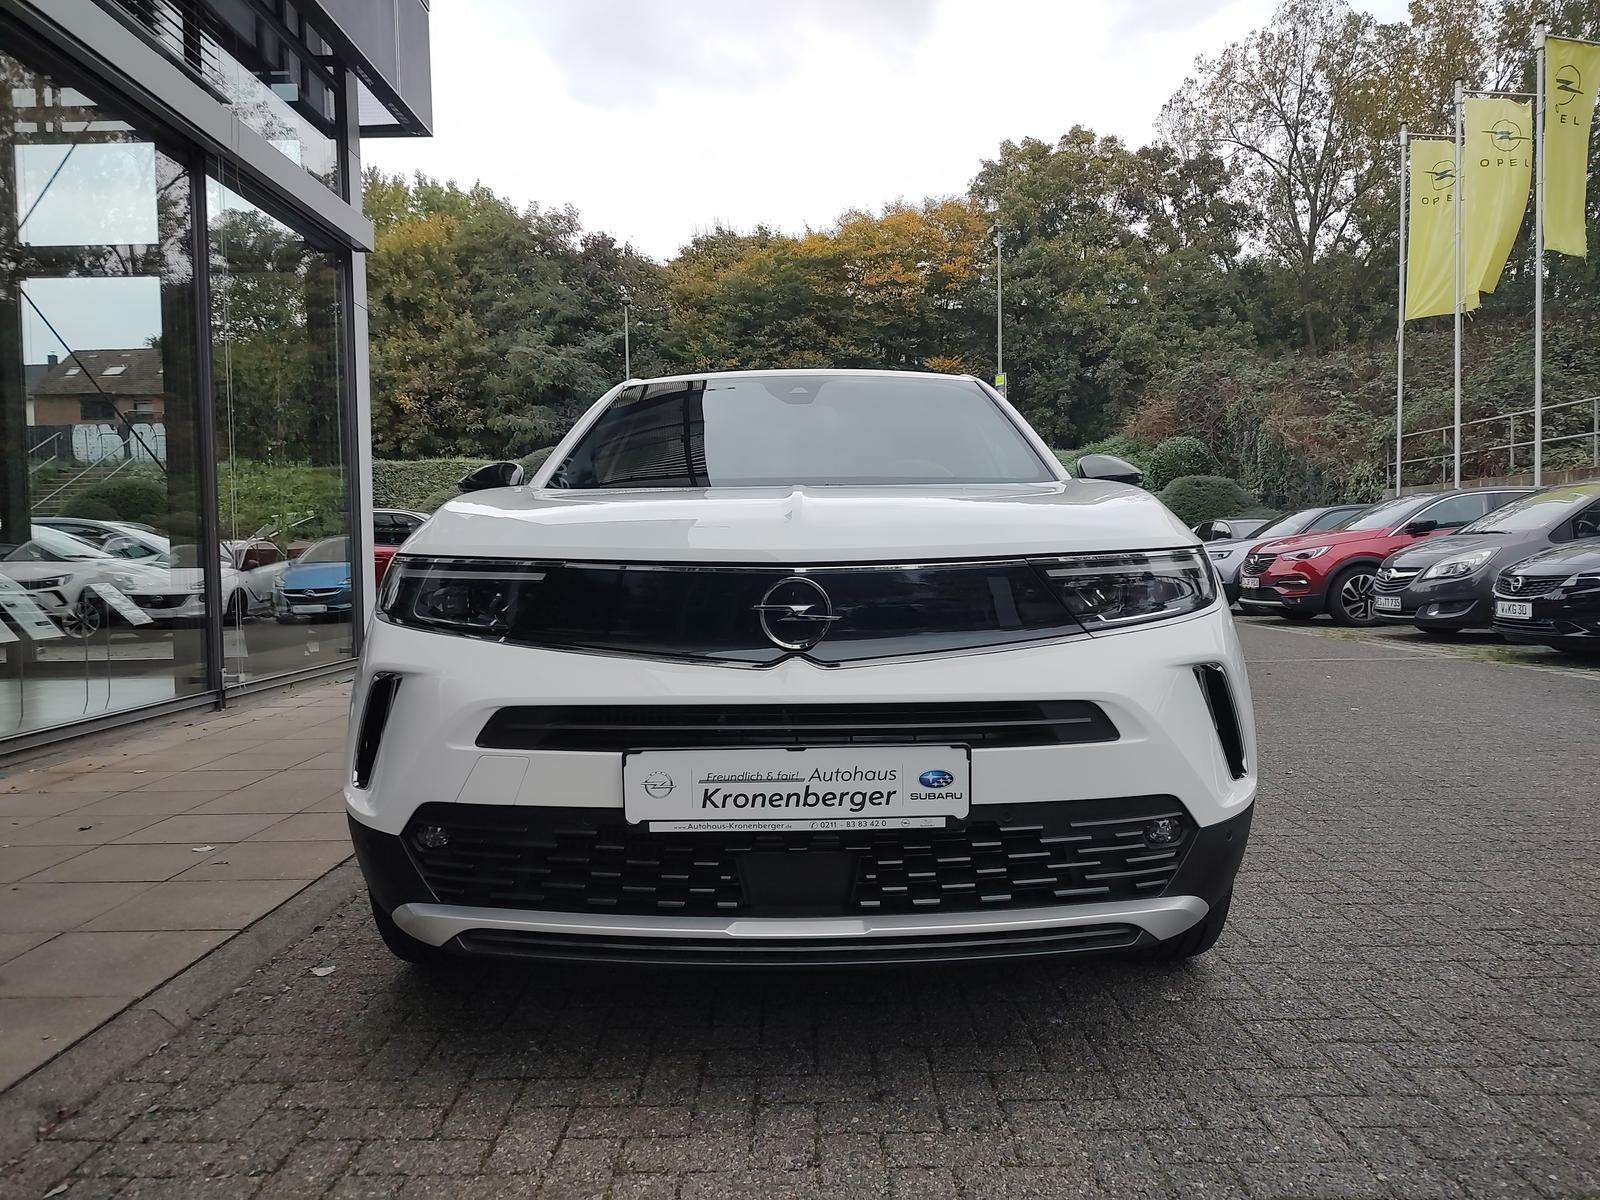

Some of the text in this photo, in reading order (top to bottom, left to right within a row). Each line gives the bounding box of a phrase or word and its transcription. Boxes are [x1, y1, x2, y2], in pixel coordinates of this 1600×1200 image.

[1480, 158, 1529, 168] OPEL
[706, 770, 800, 783] Freundlich & fair!
[808, 765, 897, 783] Autohaus
[701, 784, 898, 813] Kronenberger
[909, 792, 963, 801] SUBARU
[820, 821, 837, 829] 0211
[846, 820, 856, 828] 83
[857, 820, 868, 828] 83
[869, 820, 880, 828] 42
